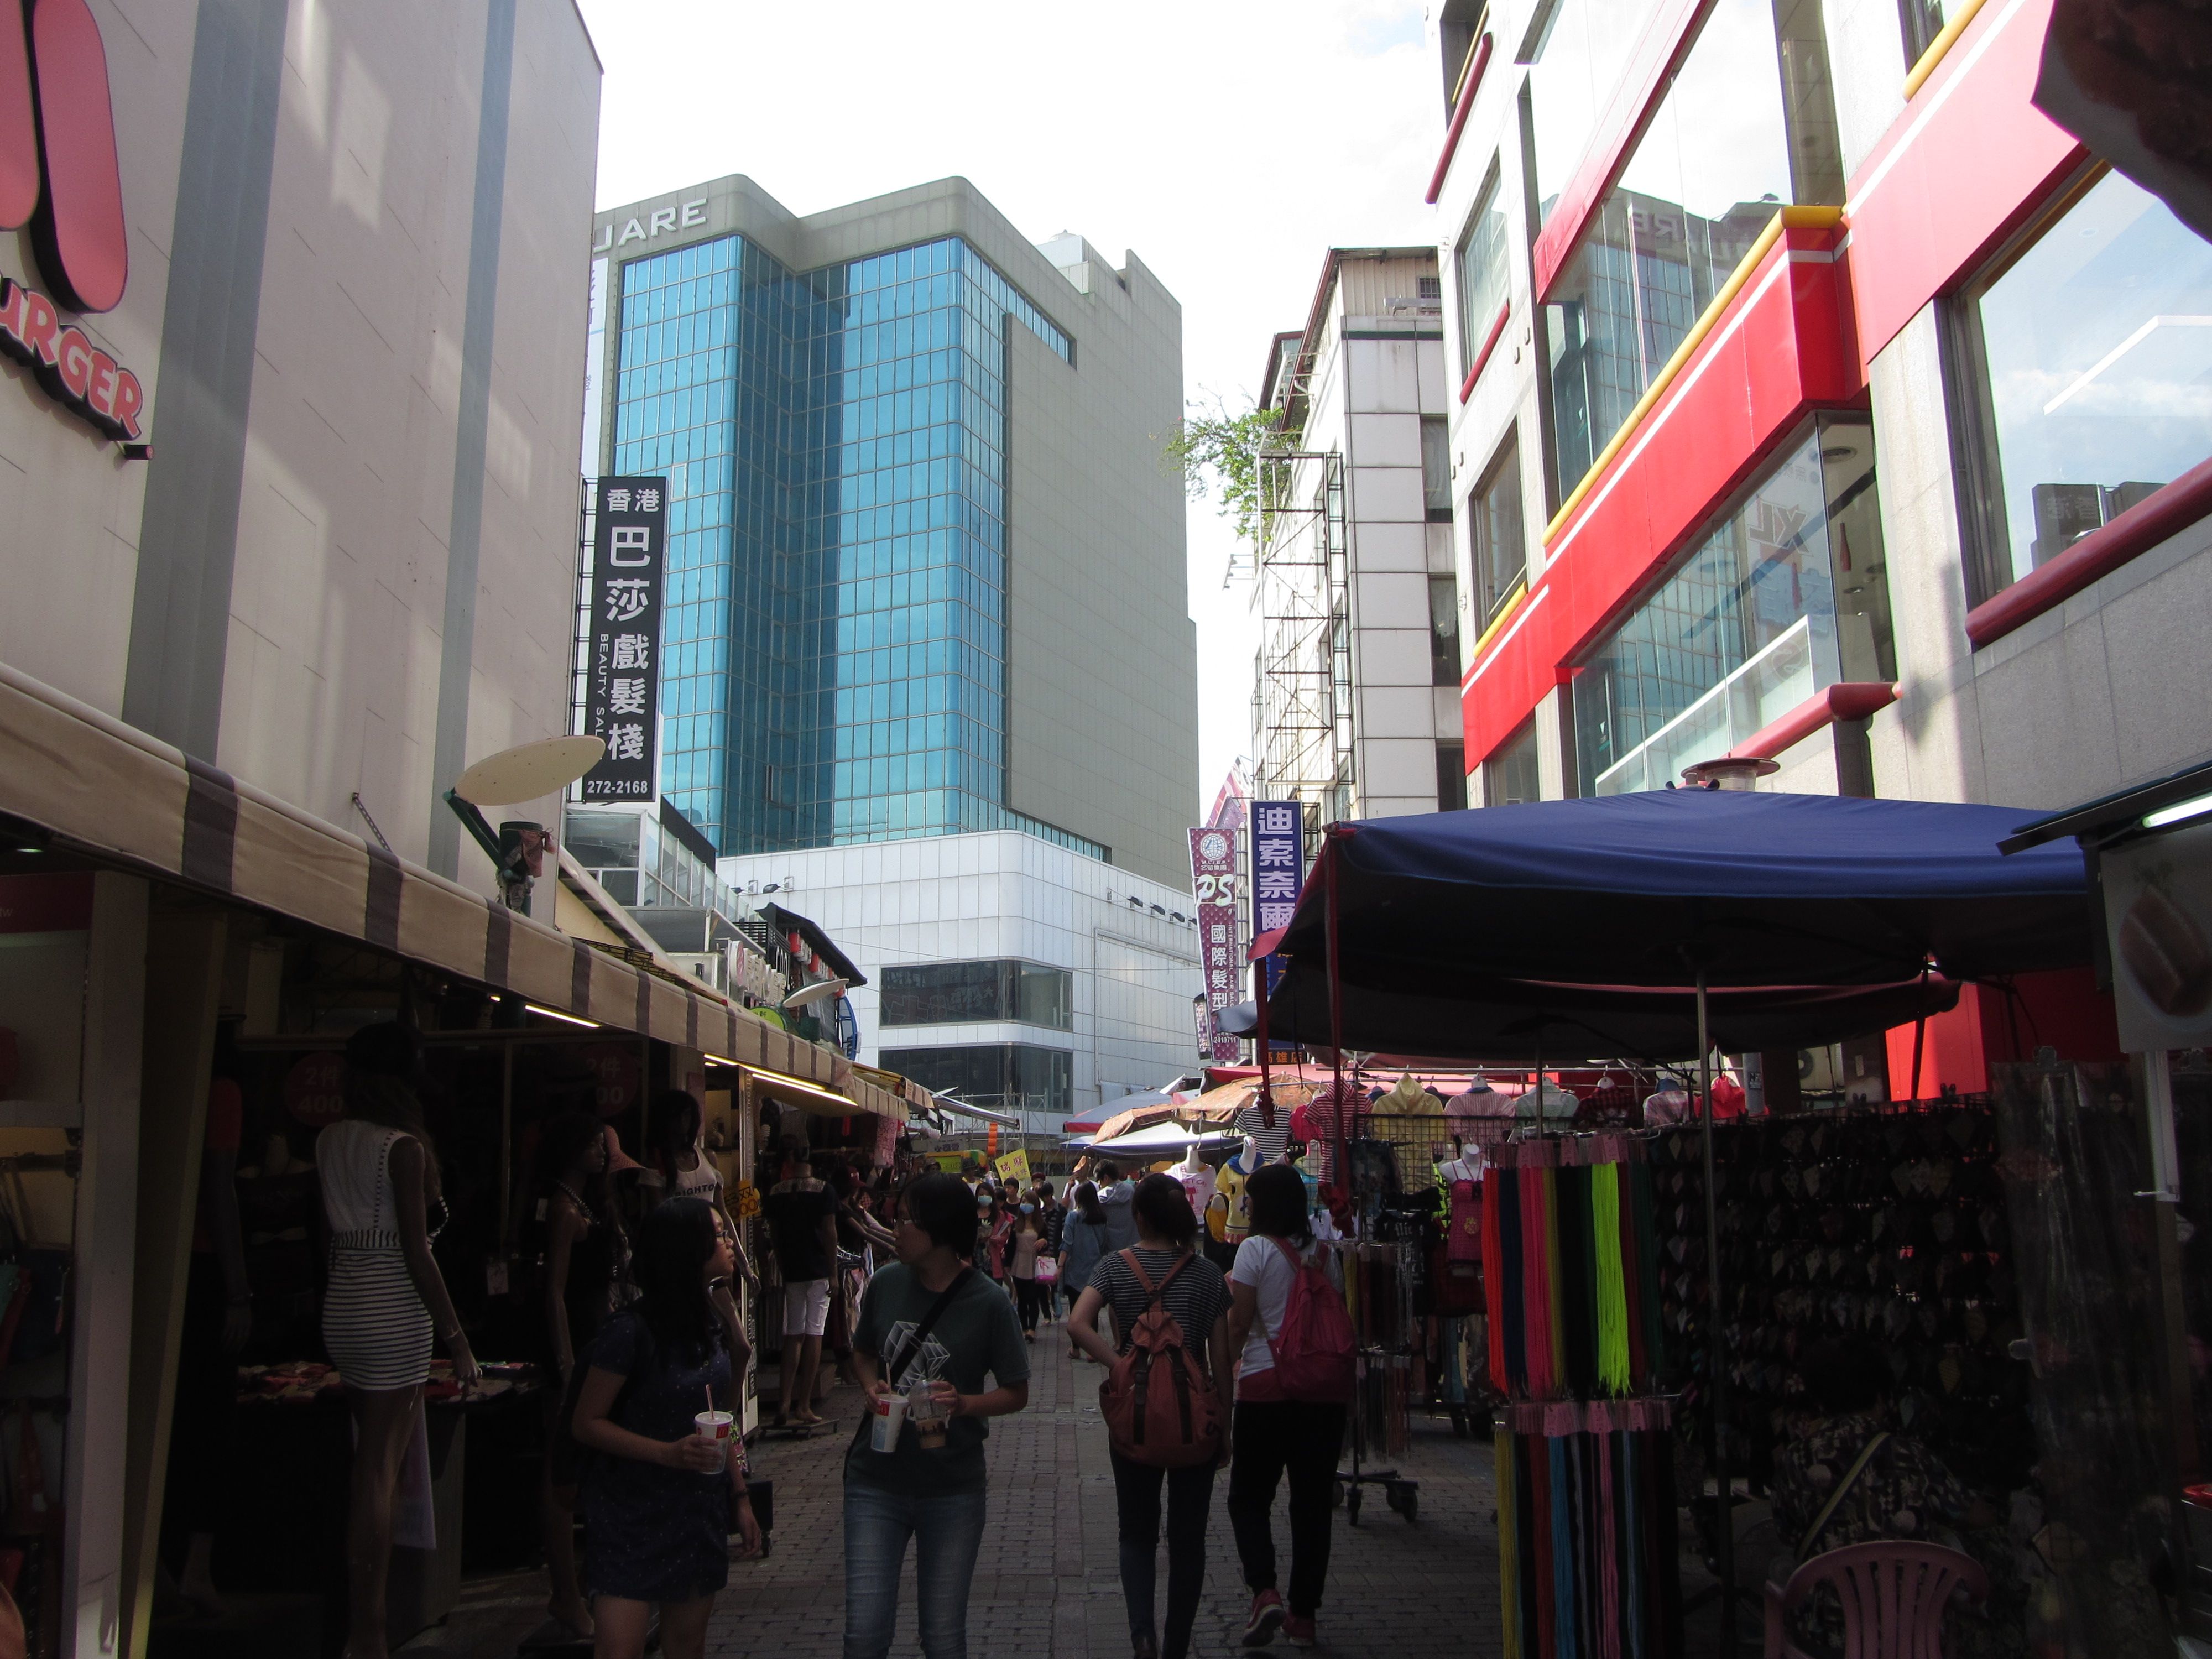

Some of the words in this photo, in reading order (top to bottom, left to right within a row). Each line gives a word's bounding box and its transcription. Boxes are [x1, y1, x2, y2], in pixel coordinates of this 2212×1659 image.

[607, 489, 659, 512] 香港
[606, 526, 651, 760] 巴莎戲髮棧
[597, 633, 609, 697] BEAUTY
[587, 780, 648, 794] 272-2168
